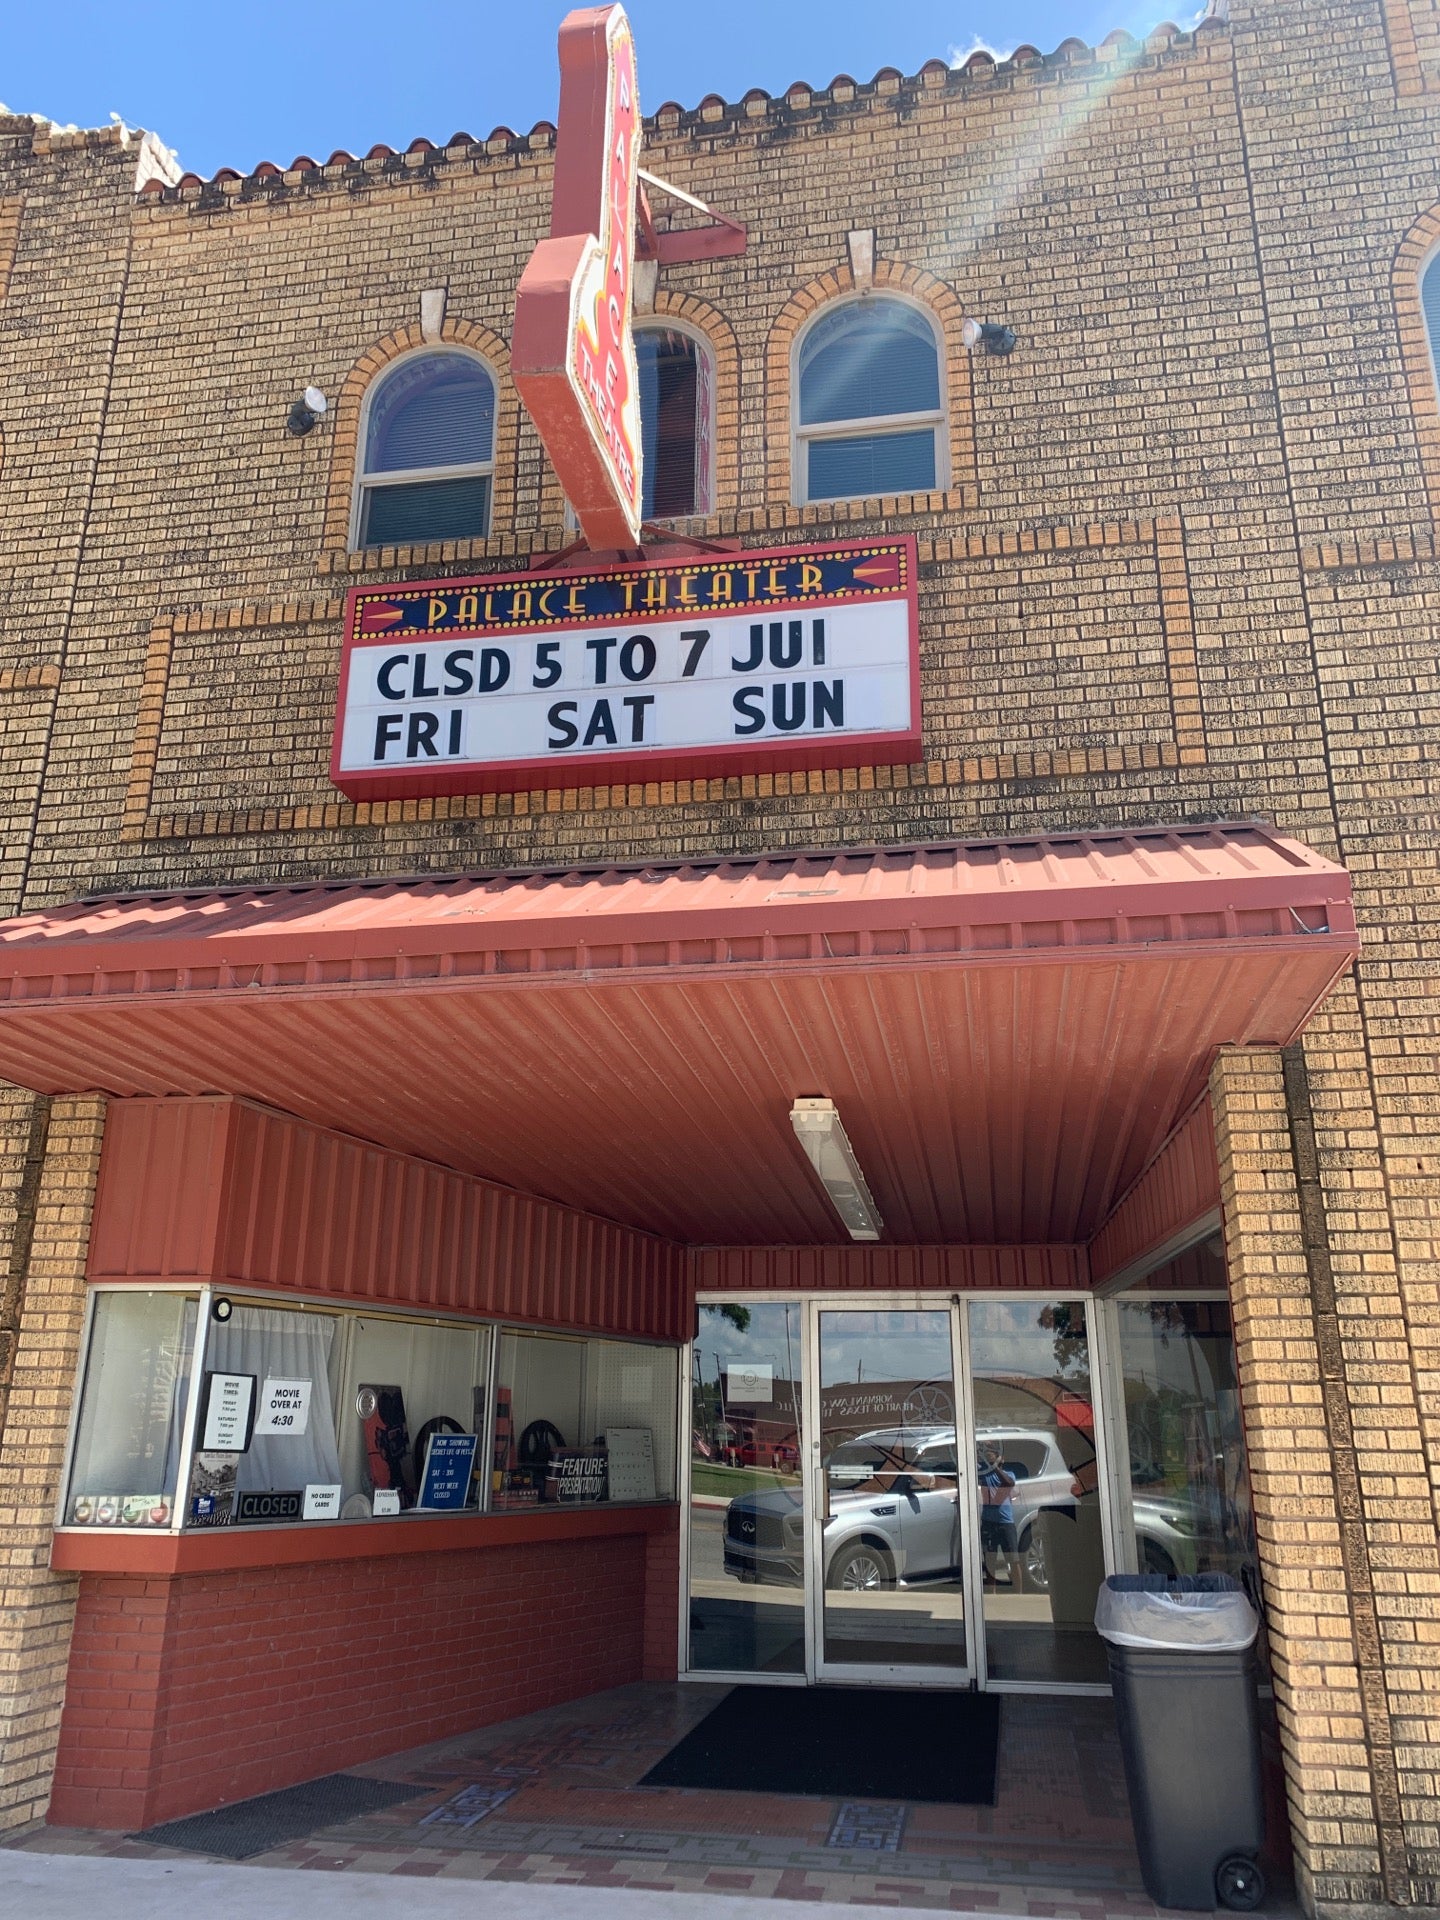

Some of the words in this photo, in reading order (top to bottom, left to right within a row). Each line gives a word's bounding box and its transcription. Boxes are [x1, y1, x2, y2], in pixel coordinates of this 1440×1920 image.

[606, 71, 630, 412] PALACE
[581, 342, 634, 502] THEATRE
[427, 587, 587, 627] PALACE
[620, 563, 825, 611] THEATER
[376, 647, 512, 701] CLSD
[533, 641, 563, 688] 5
[586, 634, 657, 684] TO
[679, 629, 711, 677] 7
[373, 708, 463, 761] FRI
[547, 695, 655, 750] SAT
[733, 679, 845, 735] SUN
[274, 1389, 301, 1398] MOVIE
[270, 1400, 291, 1409] OVER
[291, 1400, 303, 1409] AT
[271, 1415, 294, 1426] 4:30
[436, 1439, 448, 1447] NOW
[449, 1439, 471, 1447] SHOWING
[431, 1469, 441, 1477] SAT
[562, 1458, 605, 1475] FEATURE
[433, 1482, 446, 1490] NEXT
[446, 1482, 459, 1490] WEEK
[558, 1477, 602, 1494] PRESENTATION
[433, 1491, 451, 1499] CLOSED
[243, 1497, 298, 1516] CLOSED
